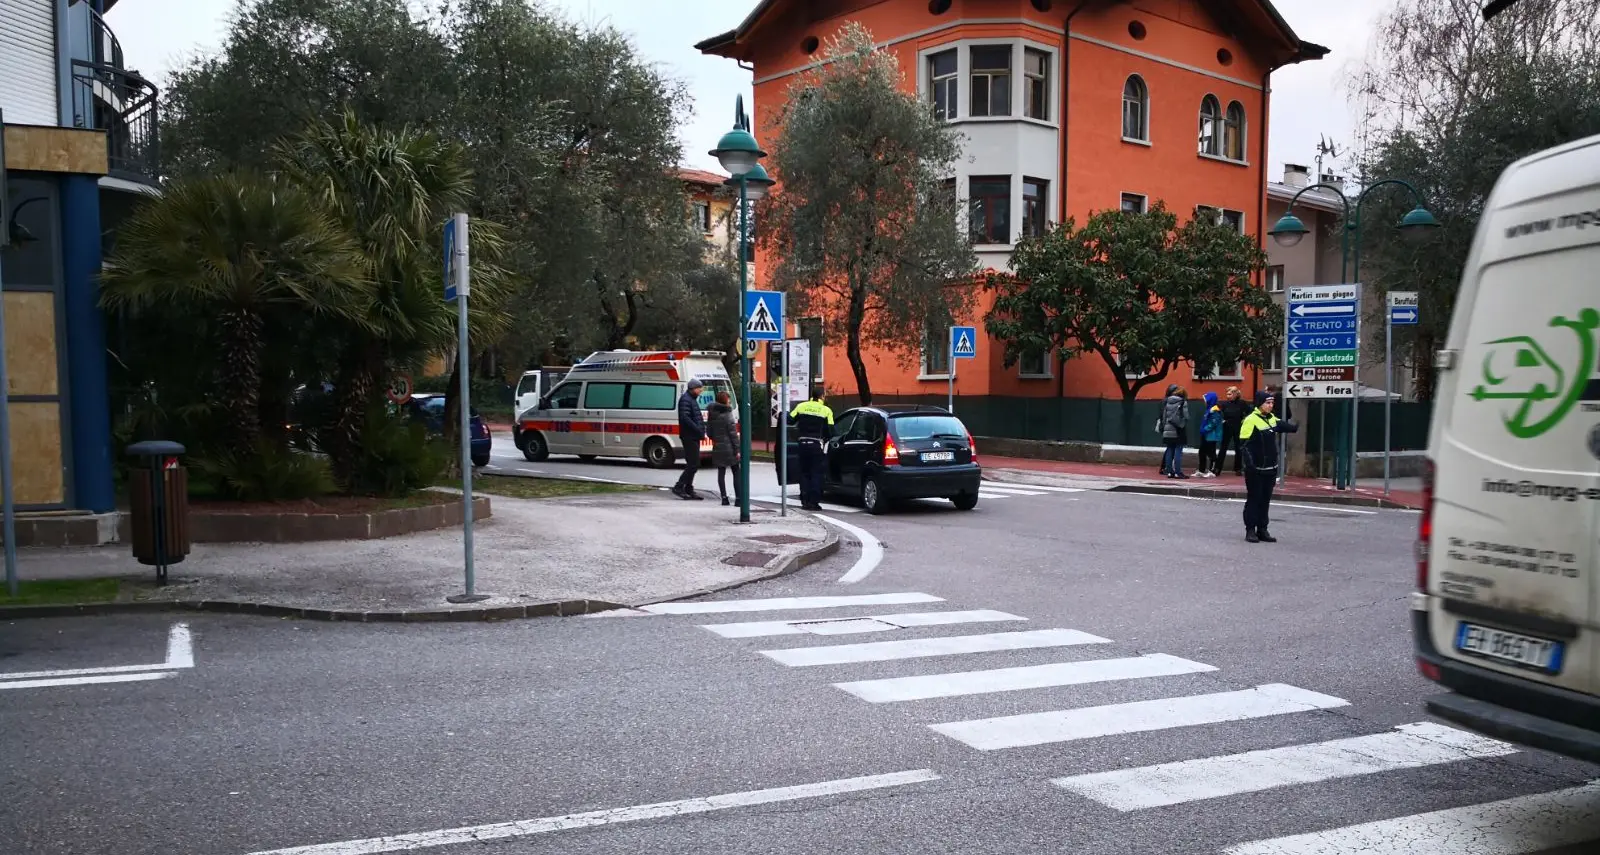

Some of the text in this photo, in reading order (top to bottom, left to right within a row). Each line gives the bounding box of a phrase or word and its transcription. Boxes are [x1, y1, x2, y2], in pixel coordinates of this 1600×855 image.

[1291, 291, 1313, 300] Martiri
[1332, 290, 1354, 299] giugno
[1303, 320, 1355, 330] TRENTO 38
[1308, 337, 1352, 345] ARCO 6
[1315, 353, 1354, 362] autostrada
[1325, 385, 1352, 395] fiera
